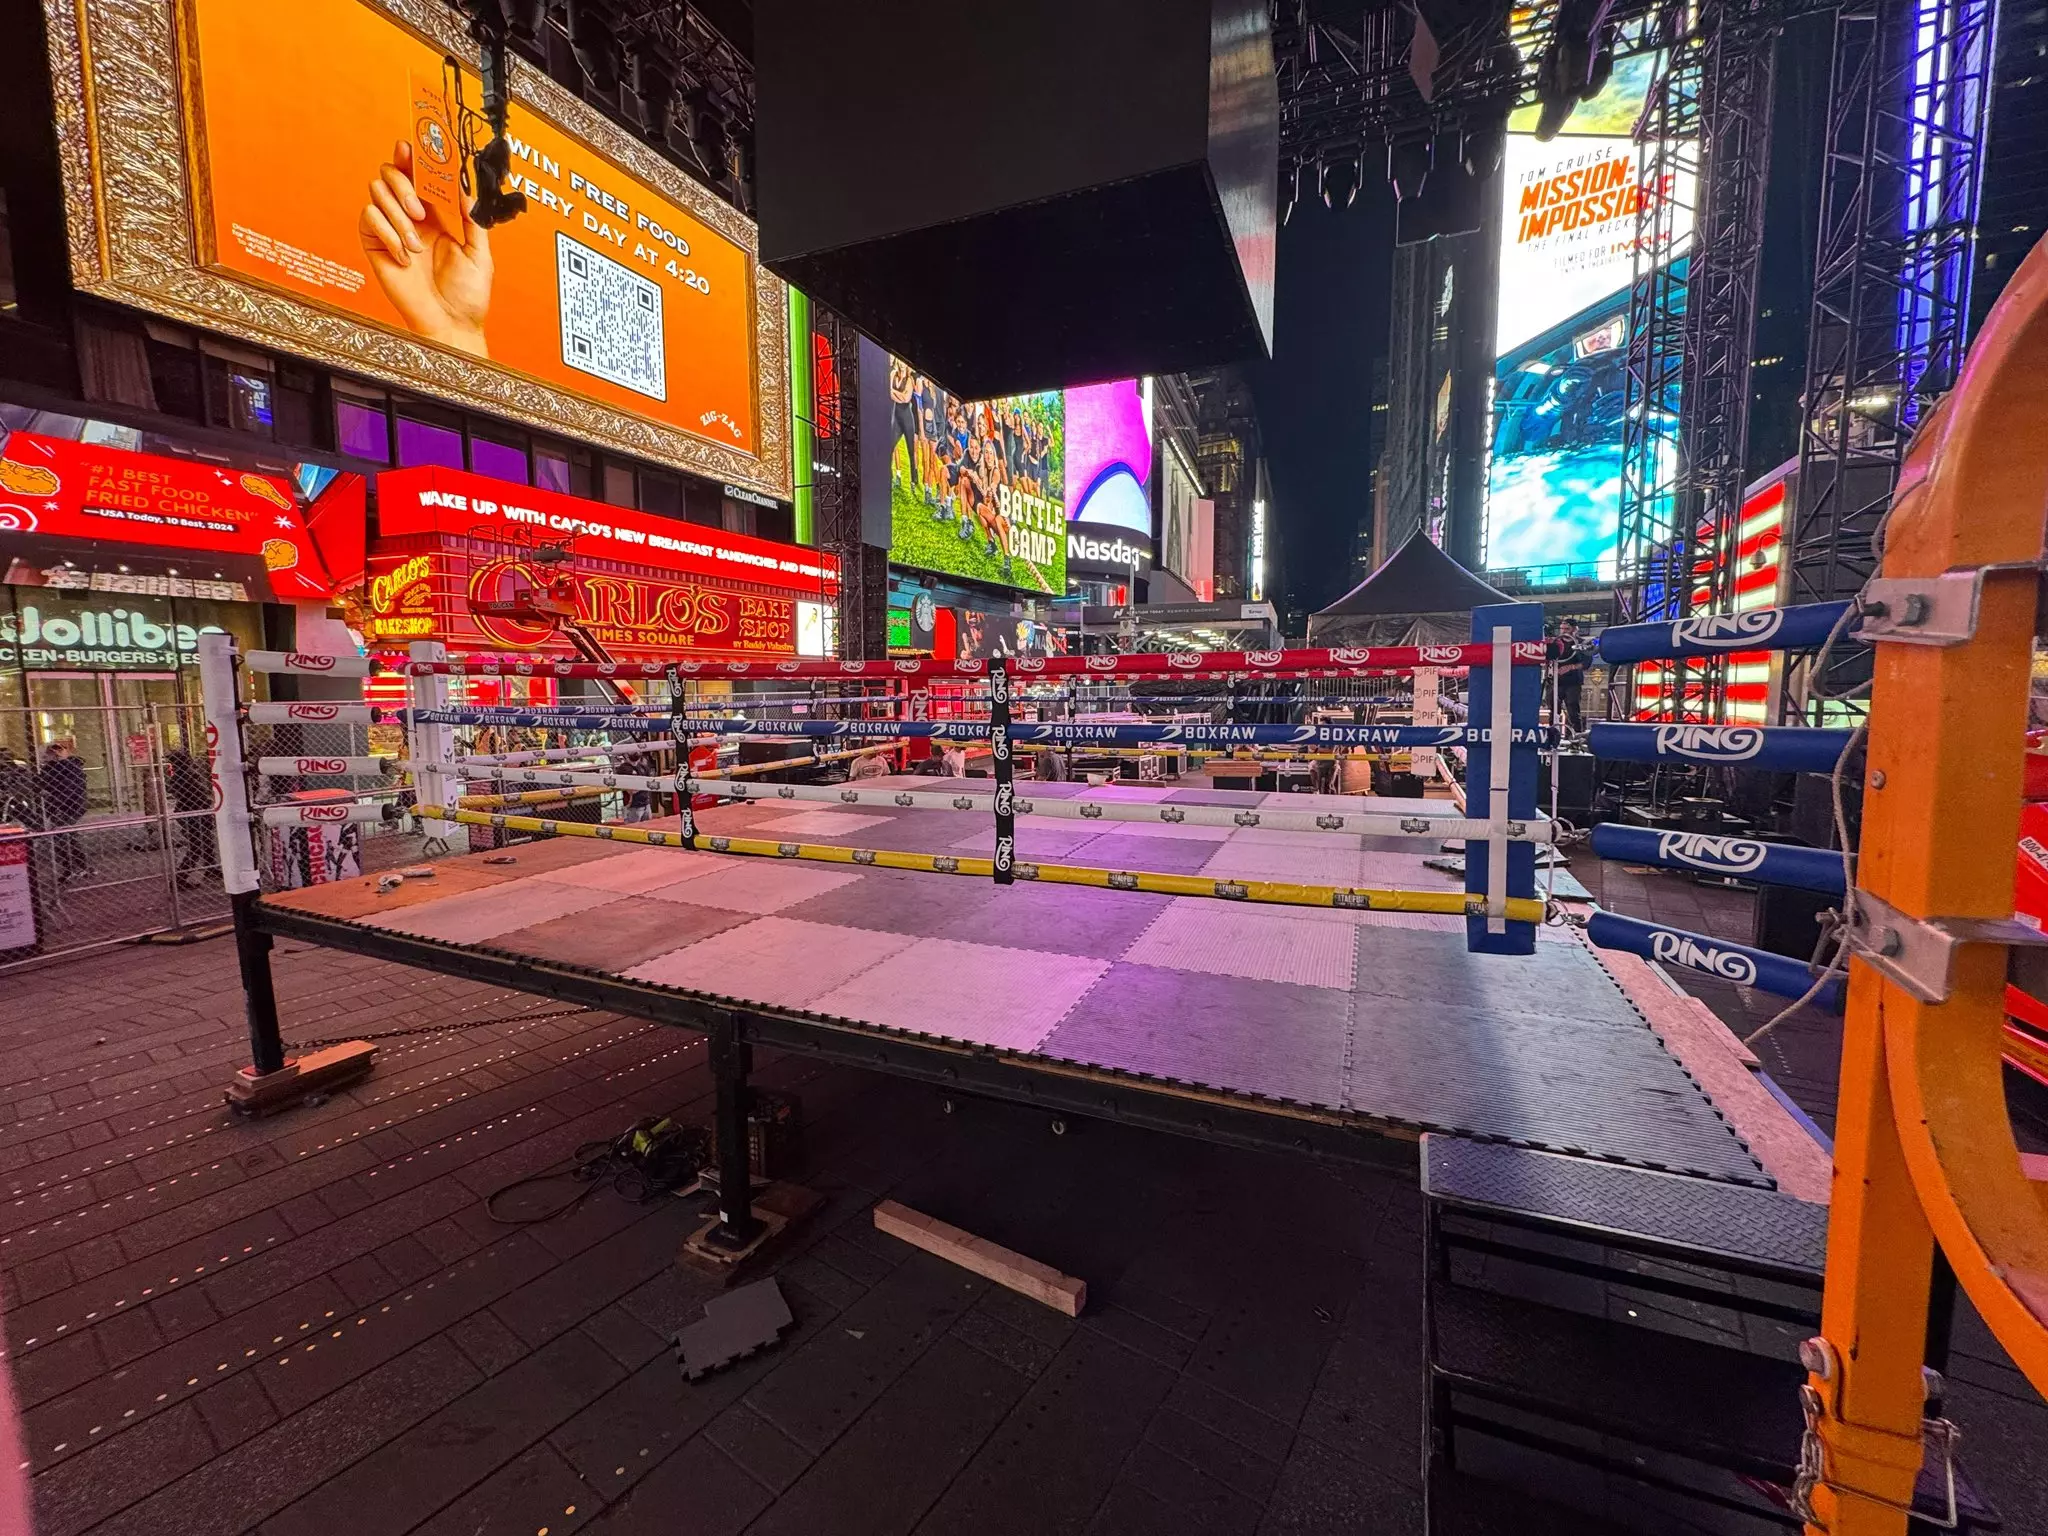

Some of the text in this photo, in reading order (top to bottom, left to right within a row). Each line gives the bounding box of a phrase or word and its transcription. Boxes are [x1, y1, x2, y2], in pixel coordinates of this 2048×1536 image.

[1520, 146, 1612, 184] TOM CRUISE
[1519, 155, 1635, 214] MISSION:
[506, 133, 560, 179] WIN
[569, 170, 630, 223] FREE
[637, 211, 690, 256] FOOD
[506, 172, 710, 295] VERY DAY AT 4:20
[700, 410, 743, 439] ZIG-ZAG
[123, 469, 172, 485] BEST
[89, 476, 210, 503] FAST FOOD
[86, 490, 149, 508] FRIED
[1000, 484, 1063, 536] BATTLE
[166, 516, 179, 525] 10
[208, 521, 234, 532] 2024
[418, 491, 467, 511] WAKE
[472, 498, 498, 516] UP
[502, 504, 546, 526] WITH
[550, 515, 612, 539] CARLO'S
[615, 527, 646, 545] NEW
[649, 535, 714, 558] BREAKFAST
[716, 547, 778, 570] SANDWICHES
[780, 561, 798, 574] AND
[1009, 526, 1057, 566] CAMP
[1068, 534, 1140, 572] Nasdaq
[371, 555, 431, 613] CARLO'S
[739, 597, 791, 619] BAKE
[739, 617, 790, 639] SHOP
[1670, 609, 1783, 647] RING
[638, 631, 695, 647] SQUARE
[744, 639, 766, 651] Buddy
[285, 653, 335, 671] RING
[1014, 656, 1045, 672] RING
[1084, 654, 1117, 670] RING
[1166, 652, 1202, 668] RING
[1243, 650, 1283, 666] RING
[1328, 648, 1370, 664] RING
[1417, 646, 1462, 664] RING
[840, 660, 865, 673] RING
[894, 660, 921, 673] RING
[954, 659, 982, 672] RING
[666, 667, 682, 698] RING
[991, 667, 1007, 704] RING
[288, 704, 339, 720] RING
[485, 713, 517, 725] BOXRAW
[543, 716, 578, 726] BOXRAW
[611, 719, 650, 729] BOXRAW
[671, 713, 685, 743] RING
[682, 720, 724, 731] BOXRAW
[758, 721, 804, 732] BOXRAW
[851, 722, 901, 734] BOXRAW
[949, 724, 990, 737] BOXRA
[1055, 726, 1118, 739] BOXRAW
[1185, 726, 1256, 740] BOXRAW
[992, 724, 1009, 760] RING
[1319, 727, 1400, 742] BOXRAW
[1467, 729, 1548, 743] BORAW
[1653, 724, 1765, 761] RING
[294, 758, 346, 775] RING
[674, 761, 689, 791] RING
[995, 781, 1011, 816] RING
[300, 806, 348, 822] RING
[681, 808, 693, 838] RING
[995, 835, 1013, 871] RING
[1658, 831, 1766, 873] RING
[1647, 932, 1757, 987] RING
